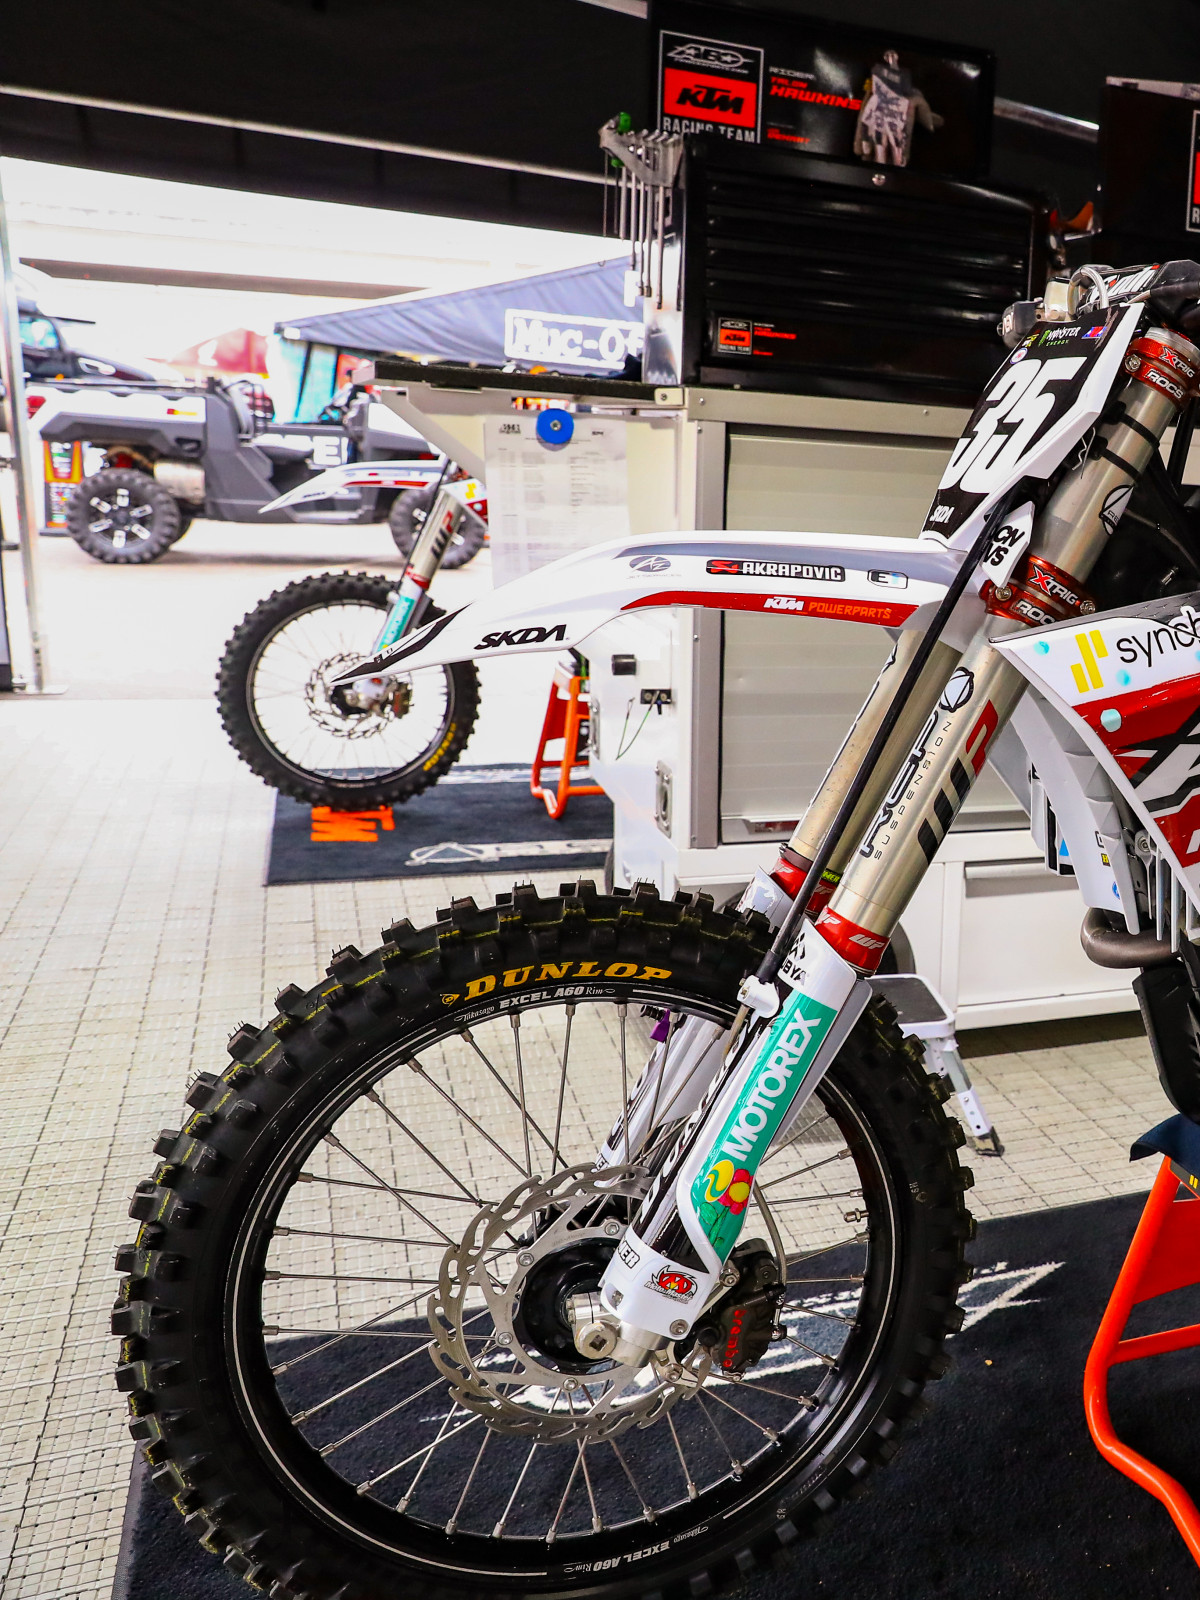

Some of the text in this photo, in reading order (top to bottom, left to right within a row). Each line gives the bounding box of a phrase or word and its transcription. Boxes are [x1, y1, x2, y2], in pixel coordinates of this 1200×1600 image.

[676, 84, 744, 114] KTM
[769, 85, 863, 110] HAWKINS
[1159, 345, 1195, 378] XTRIG
[1147, 369, 1185, 399] ROCS
[938, 357, 1088, 494] 35
[1029, 564, 1079, 606] XTRIG
[763, 596, 892, 619] KTM POWERPARTS
[1011, 599, 1057, 625] ROC
[473, 624, 567, 651] SKDA
[874, 721, 952, 859] SUSPENSION
[849, 934, 886, 950] WP
[464, 961, 673, 1001] DUNLOP
[500, 991, 551, 1009] EXCEL
[554, 986, 584, 997] A60
[586, 986, 604, 995] Rim
[722, 1008, 821, 1162] MOTOREX
[723, 1310, 747, 1368] brembo
[593, 1556, 622, 1572] A60
[623, 1540, 671, 1563] EXCEL
